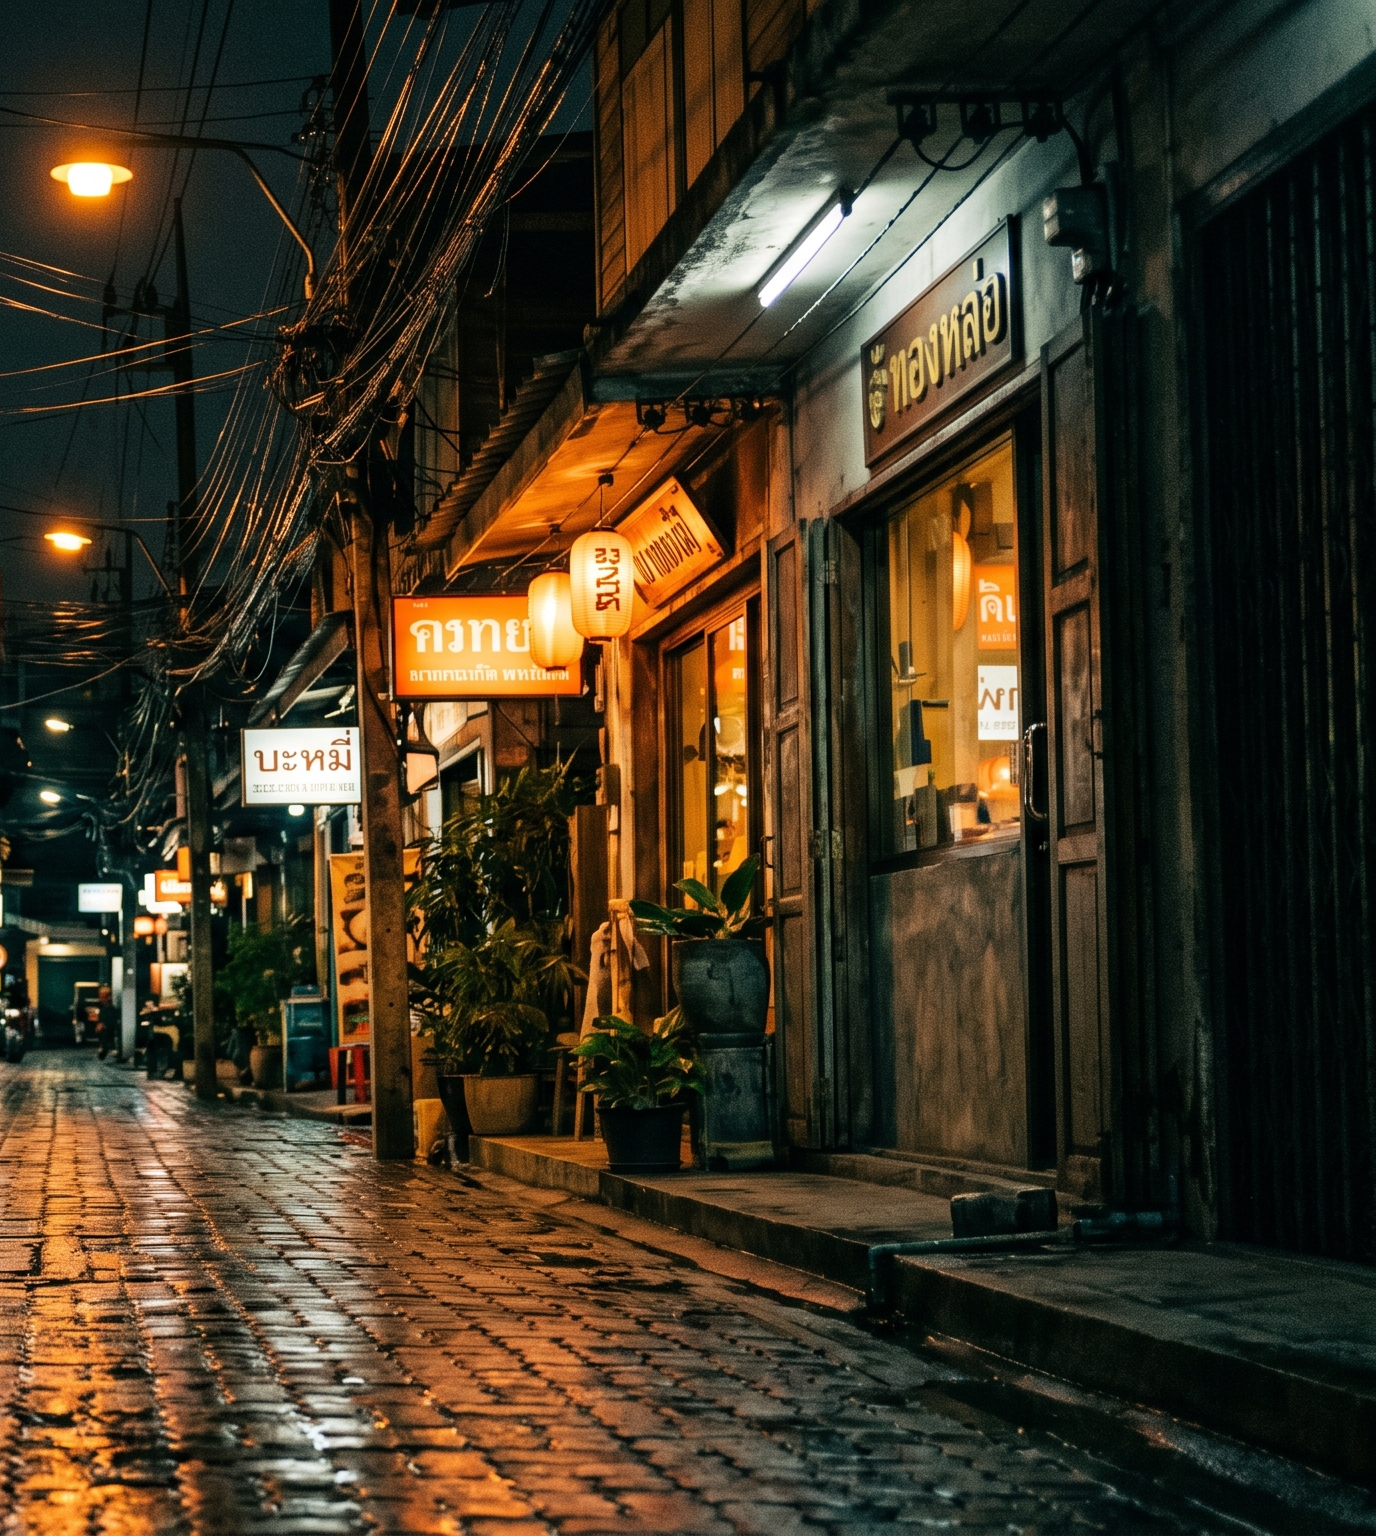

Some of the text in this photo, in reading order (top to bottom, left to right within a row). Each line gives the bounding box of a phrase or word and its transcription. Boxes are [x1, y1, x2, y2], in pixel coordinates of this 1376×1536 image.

[889, 259, 1003, 413] ทองหล่อ
[253, 729, 352, 773] บะหมี่
